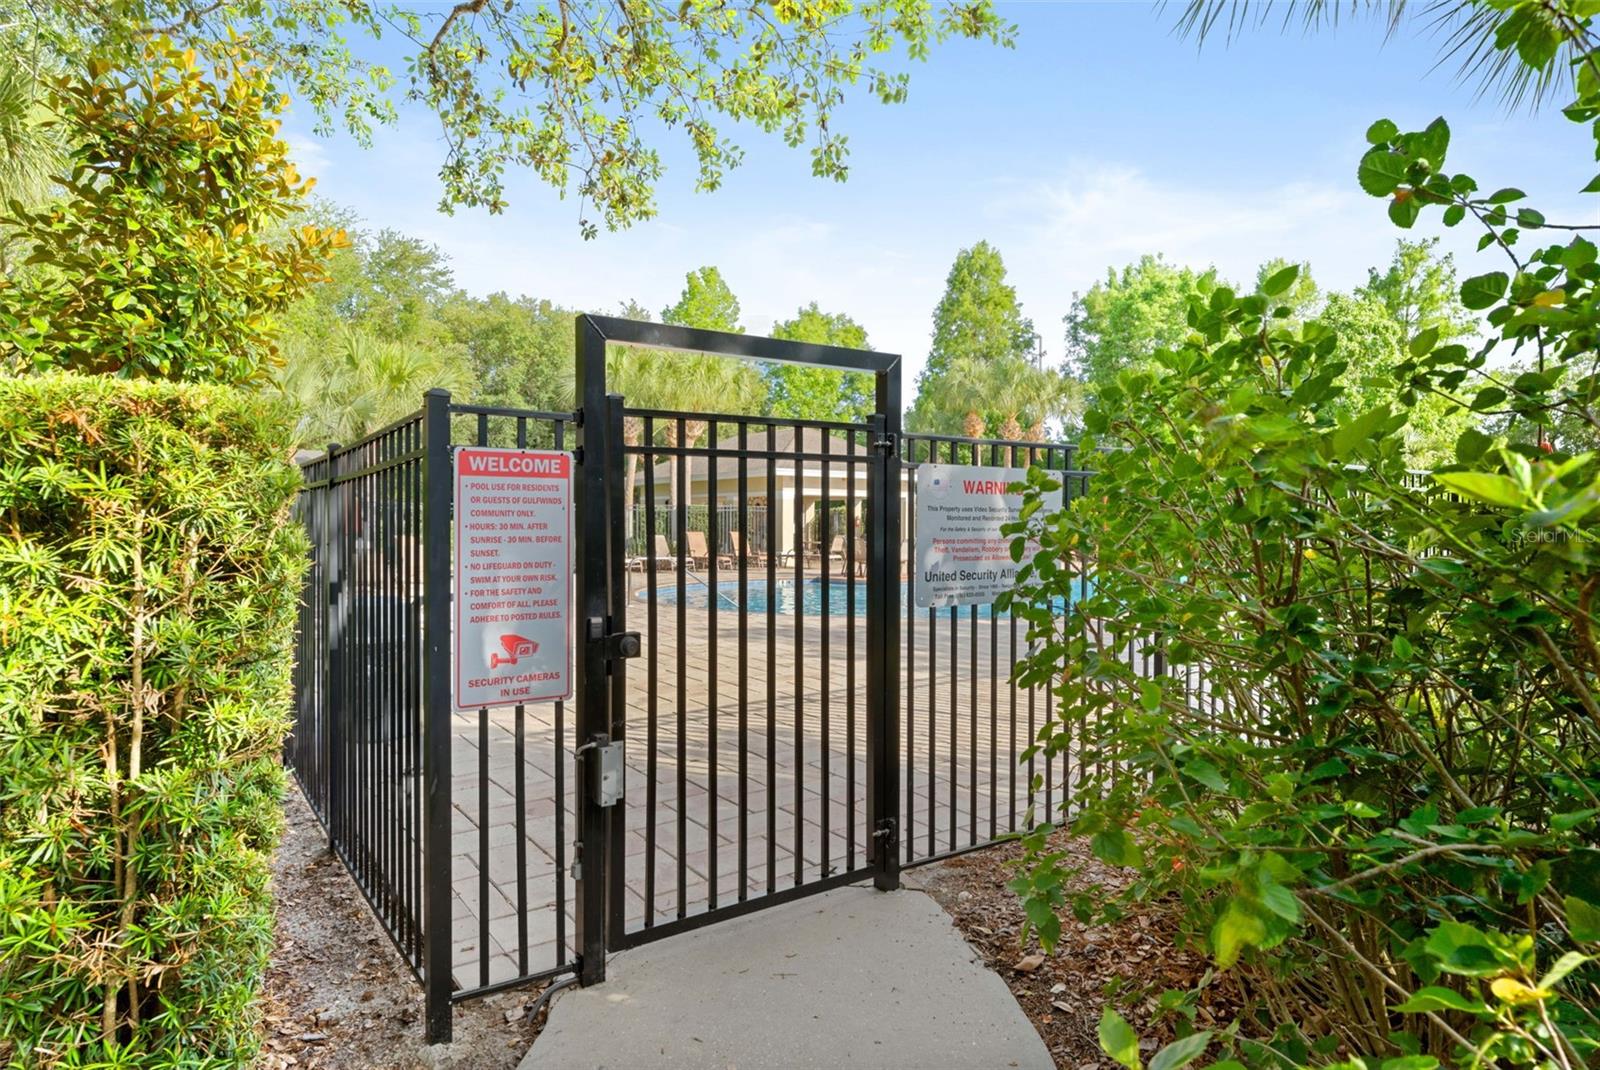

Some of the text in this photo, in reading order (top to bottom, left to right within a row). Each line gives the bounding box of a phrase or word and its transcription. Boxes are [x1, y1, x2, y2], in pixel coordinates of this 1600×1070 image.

[468, 456, 561, 474] WELCOME
[470, 482, 560, 492] POOL USE FOR RESIDENTS
[963, 480, 1023, 496] WARNI
[470, 496, 562, 505] OR GUESTS OF GULFWINDS
[516, 510, 536, 518] ONLY.
[469, 522, 497, 530] HOURS:
[498, 522, 508, 530] 30
[526, 522, 548, 530] AFTER
[470, 535, 503, 544] SUNRISE
[507, 535, 517, 543] 30
[536, 535, 562, 543] BEFORE
[470, 549, 500, 557] SUNSET.
[470, 563, 481, 571] NO
[482, 562, 521, 570] LIFEGUARD
[470, 576, 492, 584] SWIM
[501, 575, 521, 583] YOUR
[924, 570, 957, 582] United
[959, 569, 998, 583] Security
[470, 589, 485, 597] FOR
[500, 588, 527, 596] SAFETY
[527, 587, 543, 595] AND
[470, 601, 506, 610] COMFORT
[506, 601, 516, 609] OF
[532, 599, 559, 607] PLEASE
[470, 611, 562, 624] ADHERE TO POSTED RULES.
[468, 672, 561, 688] SECURITY CAMERAS
[500, 687, 531, 697] IN USE
